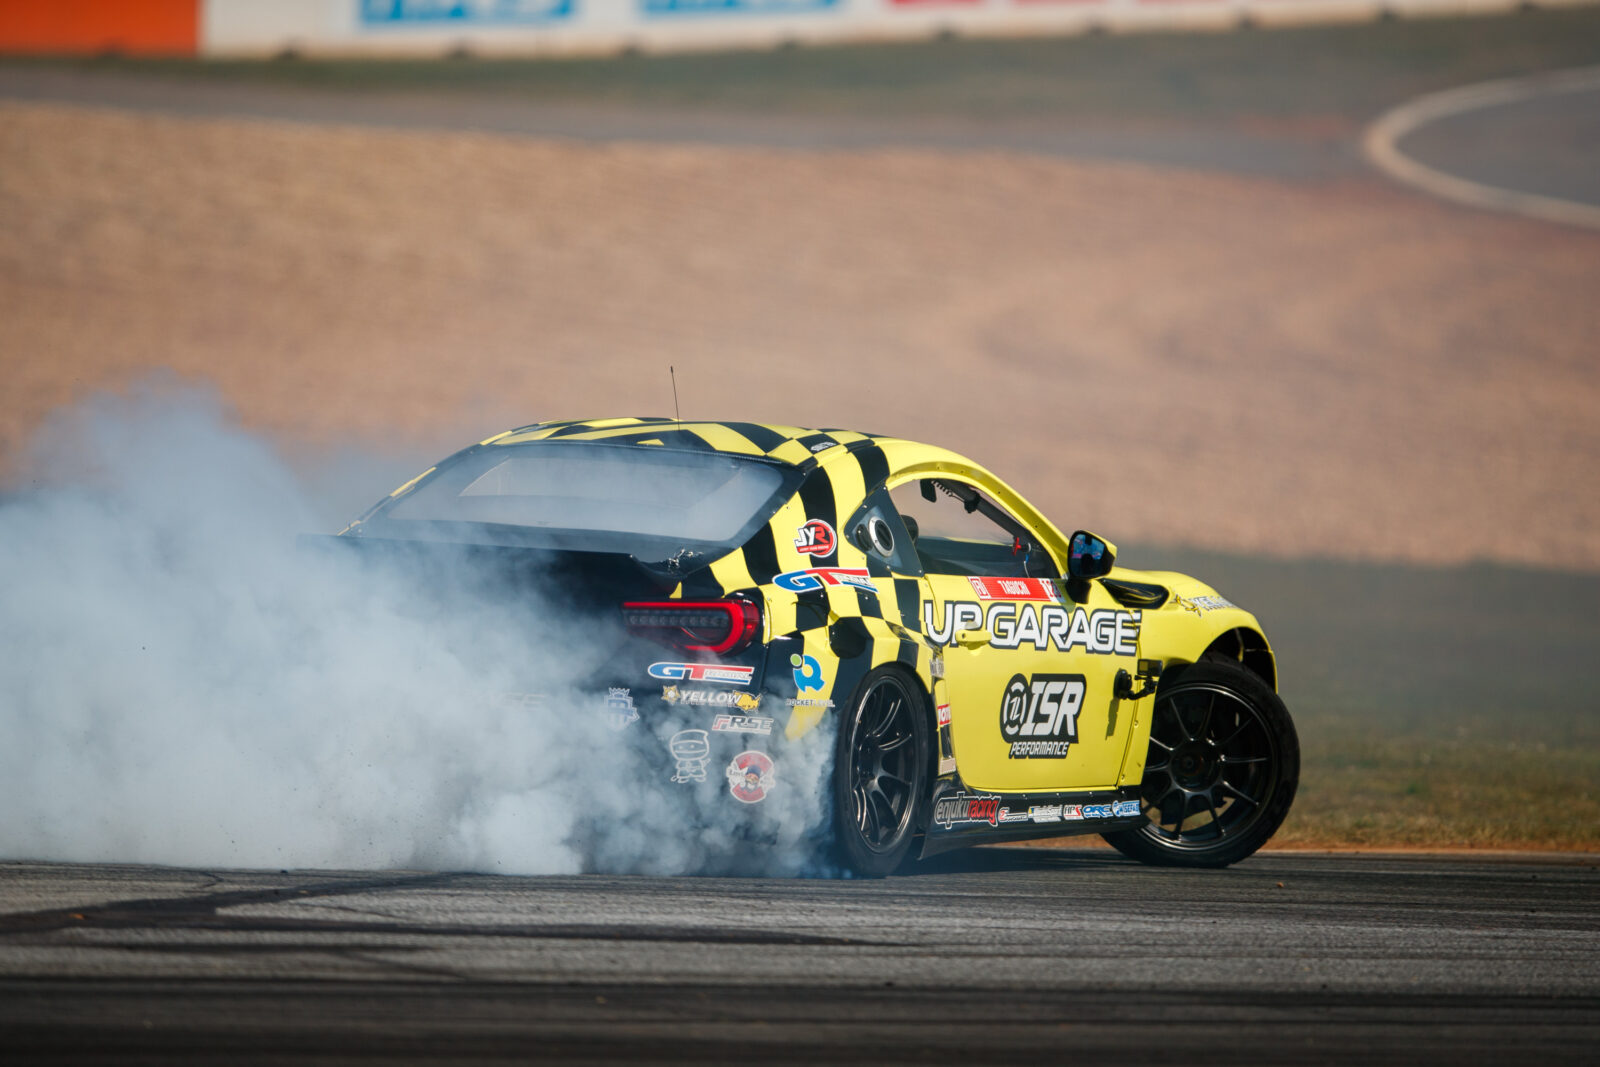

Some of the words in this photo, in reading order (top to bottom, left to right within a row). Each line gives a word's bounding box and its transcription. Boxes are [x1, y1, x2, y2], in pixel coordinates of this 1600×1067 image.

[794, 526, 829, 547] JYR
[924, 600, 983, 648] UP
[986, 602, 1142, 656] GARAGE
[680, 689, 742, 704] YELLOW
[1019, 680, 1085, 737] ISR
[1008, 741, 1070, 759] PERFORMANCE
